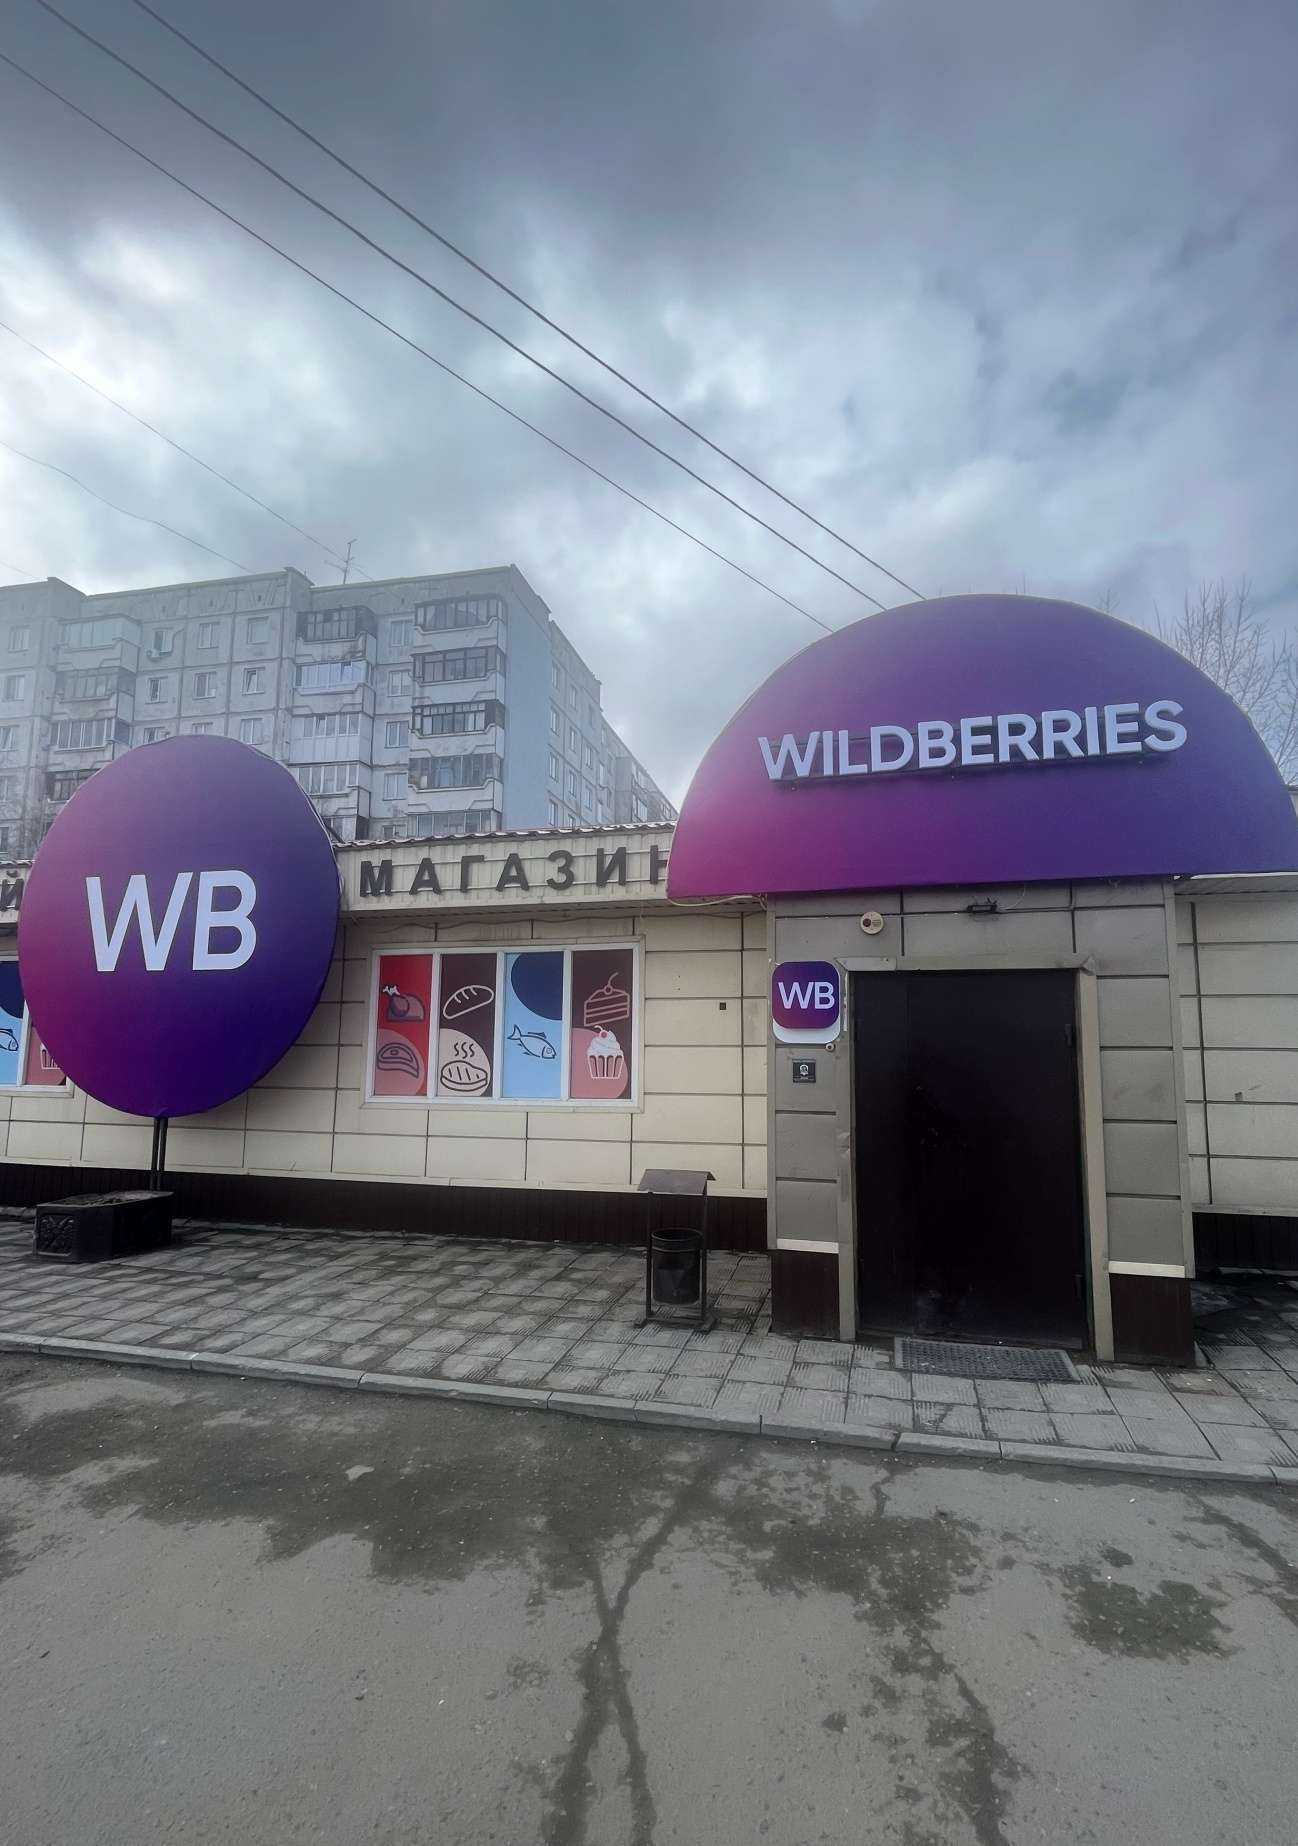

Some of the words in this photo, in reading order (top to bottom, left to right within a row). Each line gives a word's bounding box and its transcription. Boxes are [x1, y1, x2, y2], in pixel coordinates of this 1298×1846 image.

[758, 700, 1187, 780] WILDBERRIES
[86, 870, 257, 972] WB
[778, 981, 835, 1010] WB
